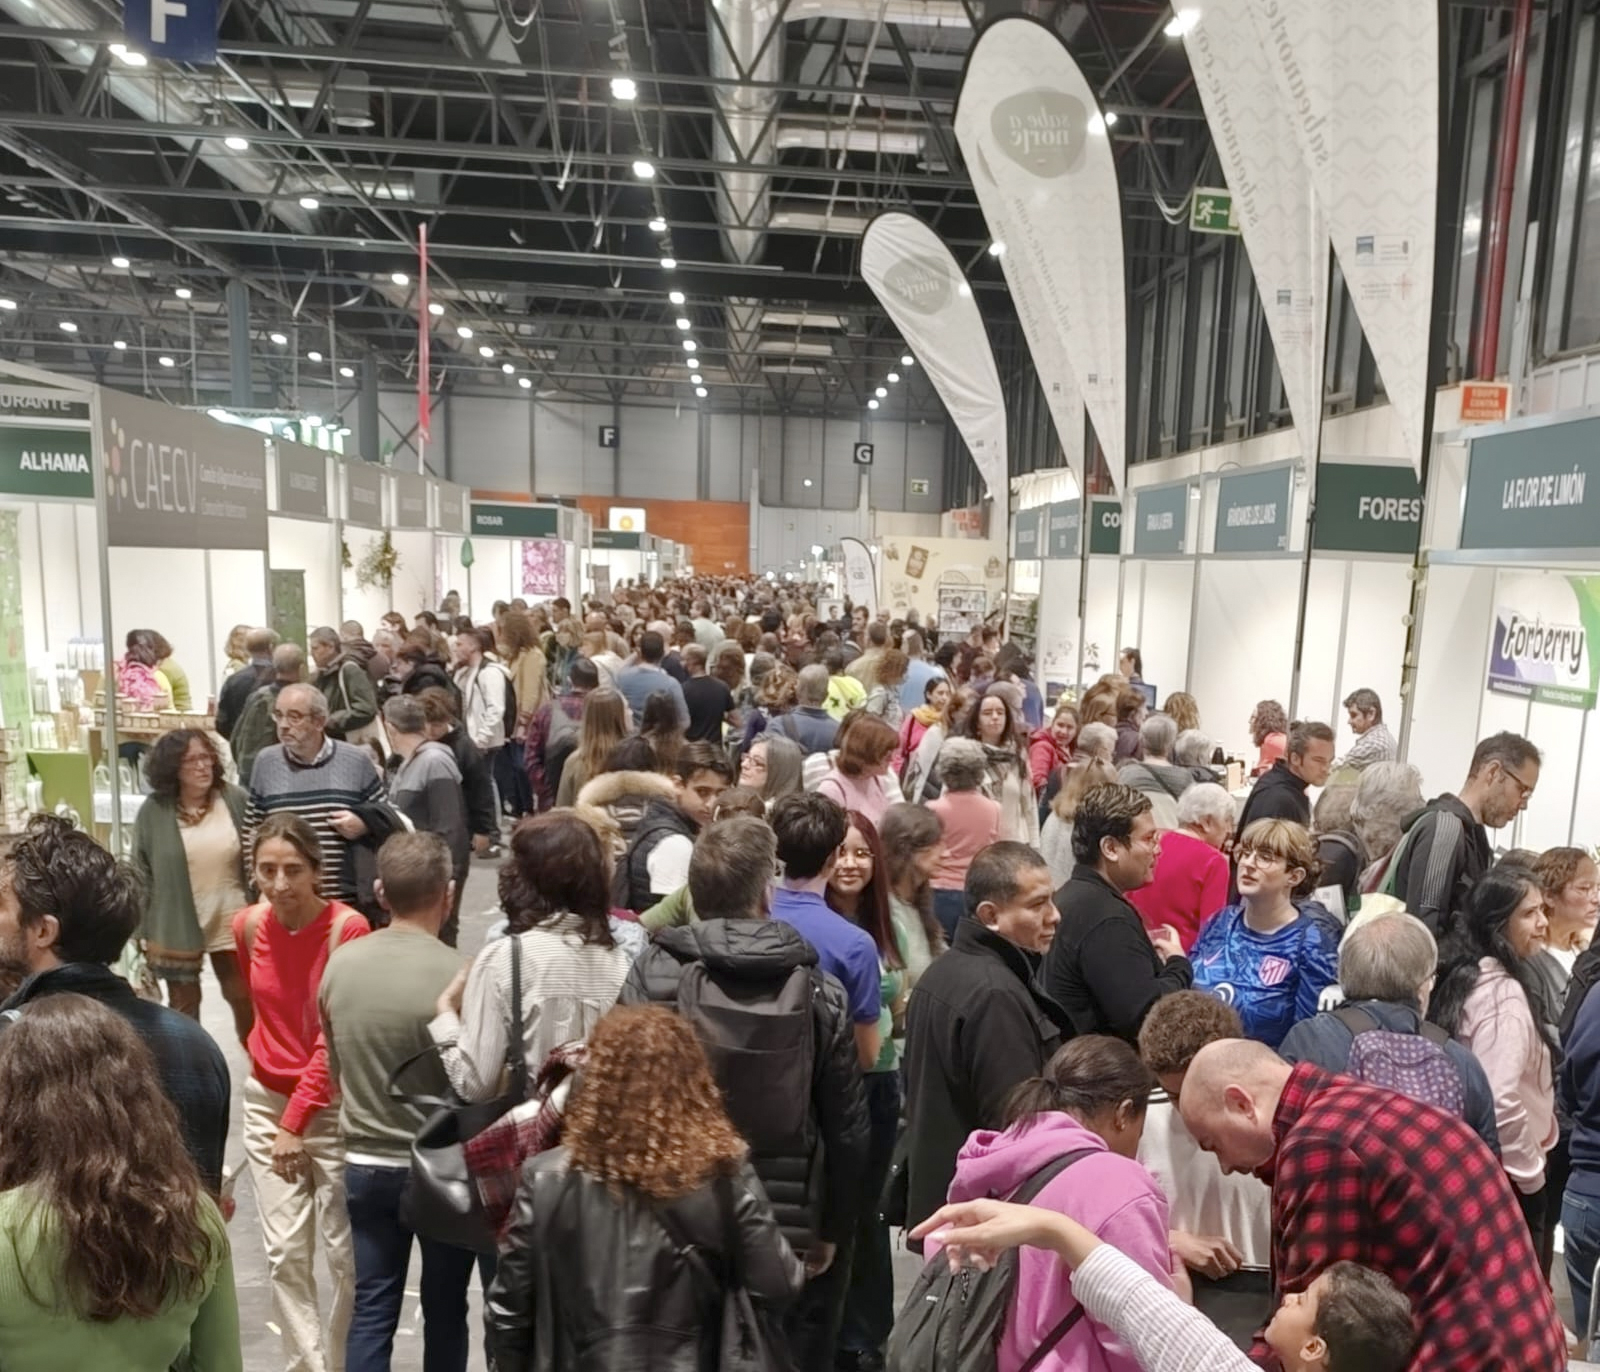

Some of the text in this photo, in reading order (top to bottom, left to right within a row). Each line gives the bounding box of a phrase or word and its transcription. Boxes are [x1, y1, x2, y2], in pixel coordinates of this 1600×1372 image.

[151, 0, 187, 43] F
[604, 429, 614, 445] F
[20, 450, 90, 473] ALHAMA
[856, 445, 871, 462] G
[130, 439, 197, 513] CAECV
[1502, 464, 1585, 510] LA FLOR DE LIMÓN
[1102, 511, 1122, 528] CO
[1358, 495, 1425, 523] FORES
[1503, 614, 1585, 675] Forberry
